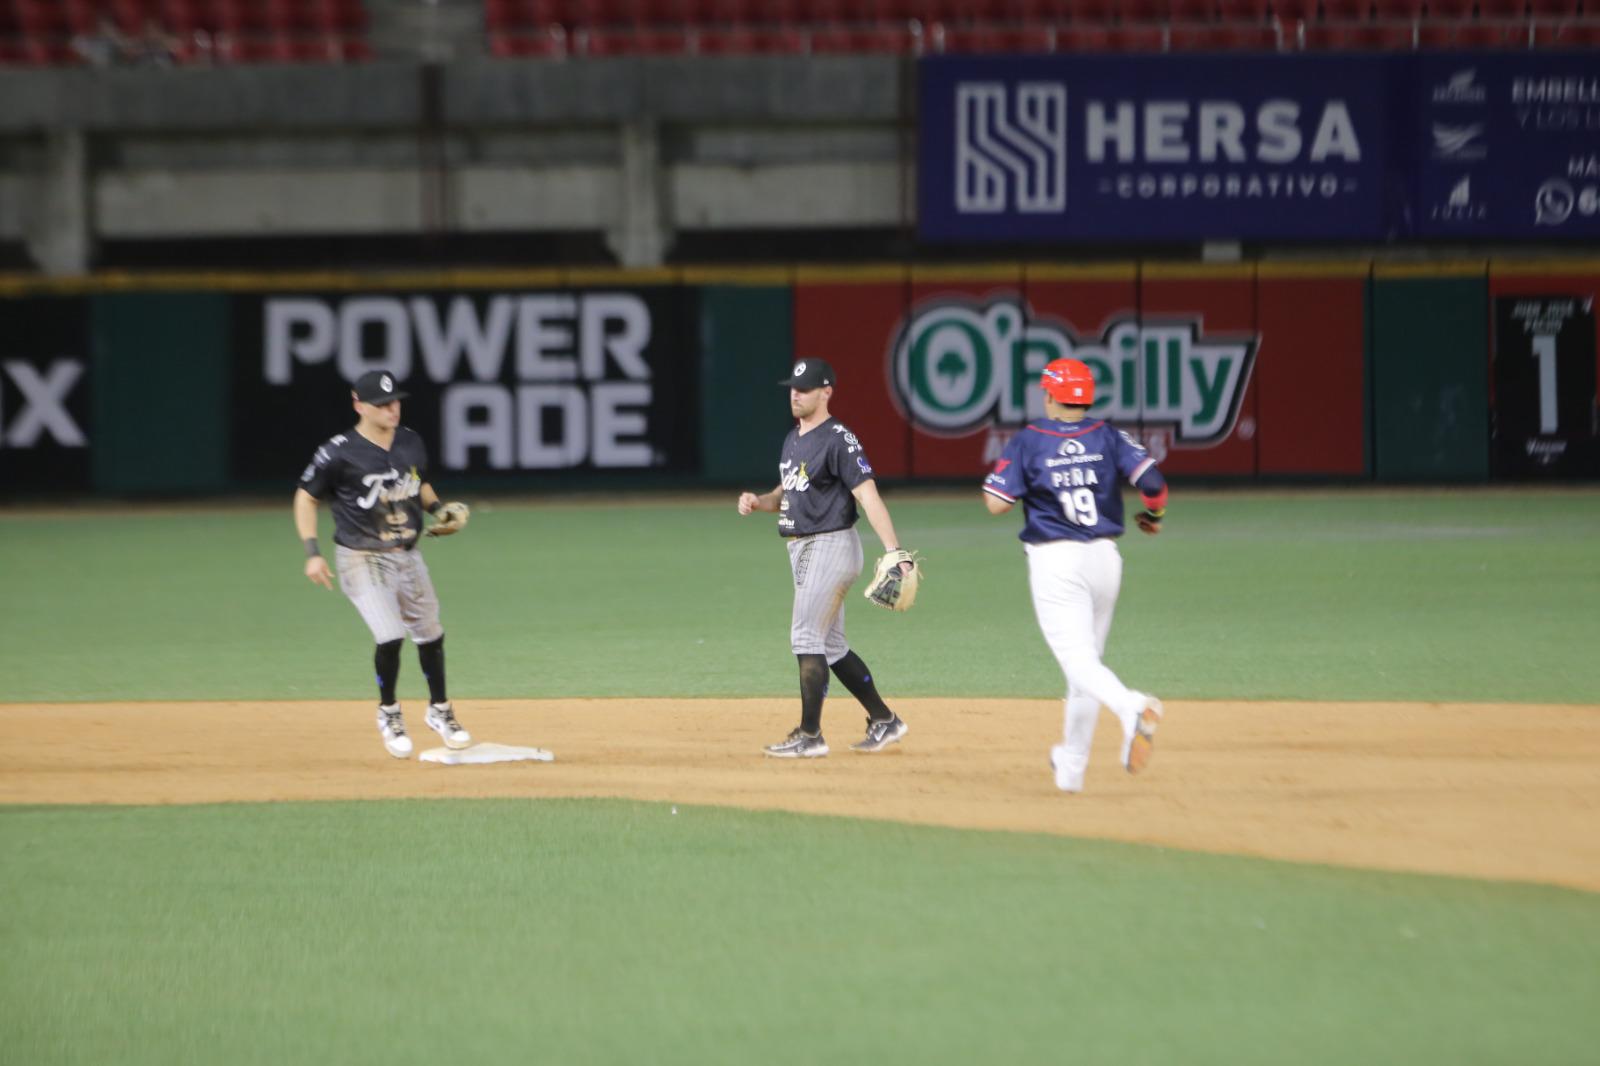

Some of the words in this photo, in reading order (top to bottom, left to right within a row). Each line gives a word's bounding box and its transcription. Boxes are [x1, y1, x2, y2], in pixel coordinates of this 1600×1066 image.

[1086, 102, 1361, 162] HERSA
[1116, 172, 1339, 199] CORPORATIVO
[264, 295, 652, 384] POWER
[896, 303, 1246, 438] O'Reilly
[1532, 335, 1558, 434] 1
[442, 384, 652, 470] ADE
[1051, 467, 1098, 488] PEÑA
[1059, 487, 1098, 526] 19
